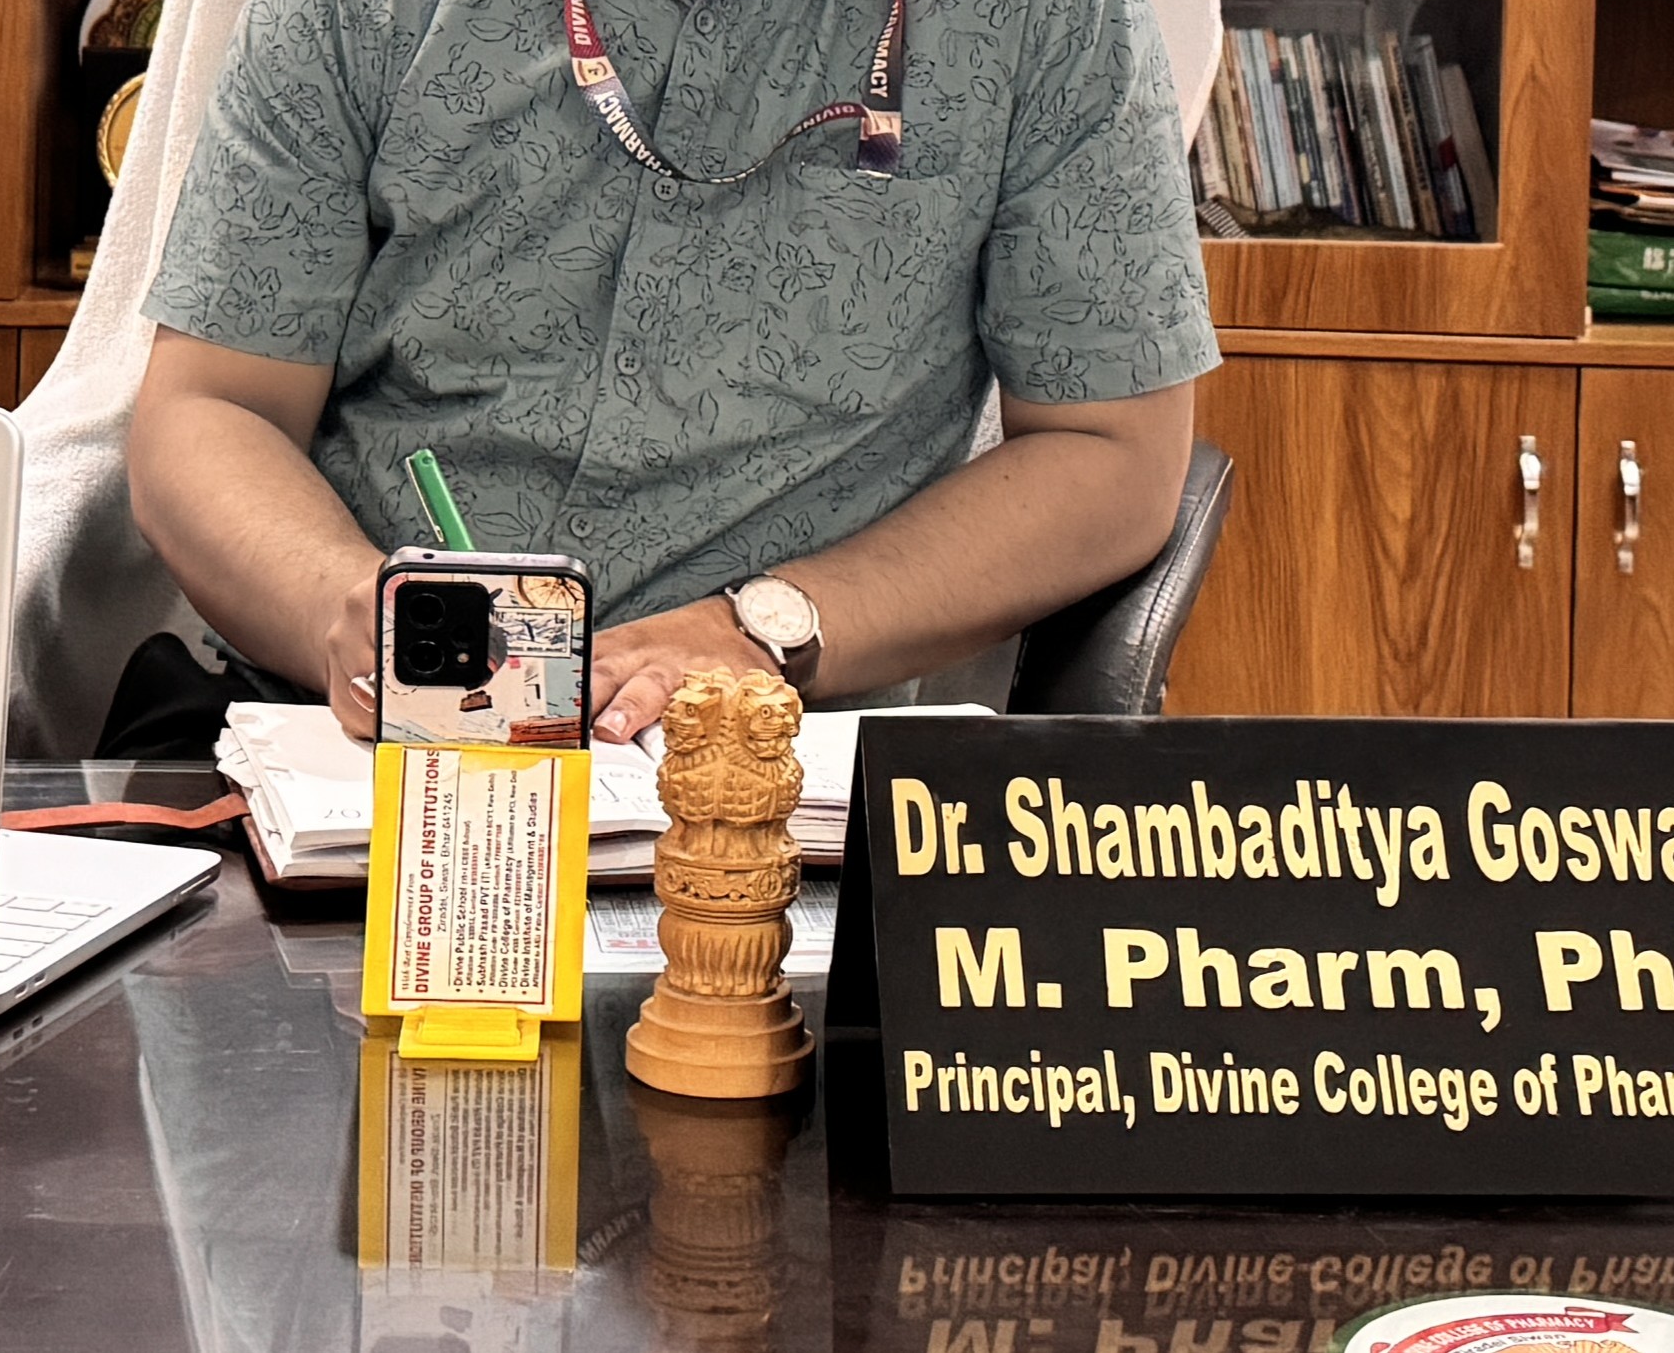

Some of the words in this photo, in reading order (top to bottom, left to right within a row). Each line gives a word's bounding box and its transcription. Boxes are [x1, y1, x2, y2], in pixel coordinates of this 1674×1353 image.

[422, 749, 440, 854] INSTITUTIONS
[527, 793, 537, 828] Studies
[527, 830, 536, 838] &
[890, 778, 985, 877] Dr.
[1005, 777, 1449, 907] Shambaditya
[420, 859, 434, 879] OF
[503, 856, 515, 904] Pharmacy
[418, 884, 434, 936] GROUP
[456, 887, 468, 920] School
[480, 887, 490, 905] PVT
[502, 906, 511, 916] of
[523, 903, 532, 913] of
[455, 924, 466, 953] Public
[478, 909, 489, 941] Prasad
[500, 919, 512, 954] College
[522, 917, 532, 954] Institute
[415, 941, 431, 993] DIVINE
[453, 956, 464, 986] Divine
[477, 944, 487, 986] Subhash
[499, 958, 508, 987] Divine
[520, 958, 530, 987] Divine
[934, 927, 1064, 1010] M.
[1103, 927, 1502, 1033] Pharm,
[903, 1050, 1135, 1130] Principal,
[1151, 1051, 1300, 1115] Divine
[1313, 1051, 1498, 1131] College
[1514, 1052, 1559, 1116] of
[1432, 1322, 1484, 1350] COLLEGE
[1505, 1315, 1595, 1330] PHARMACY
